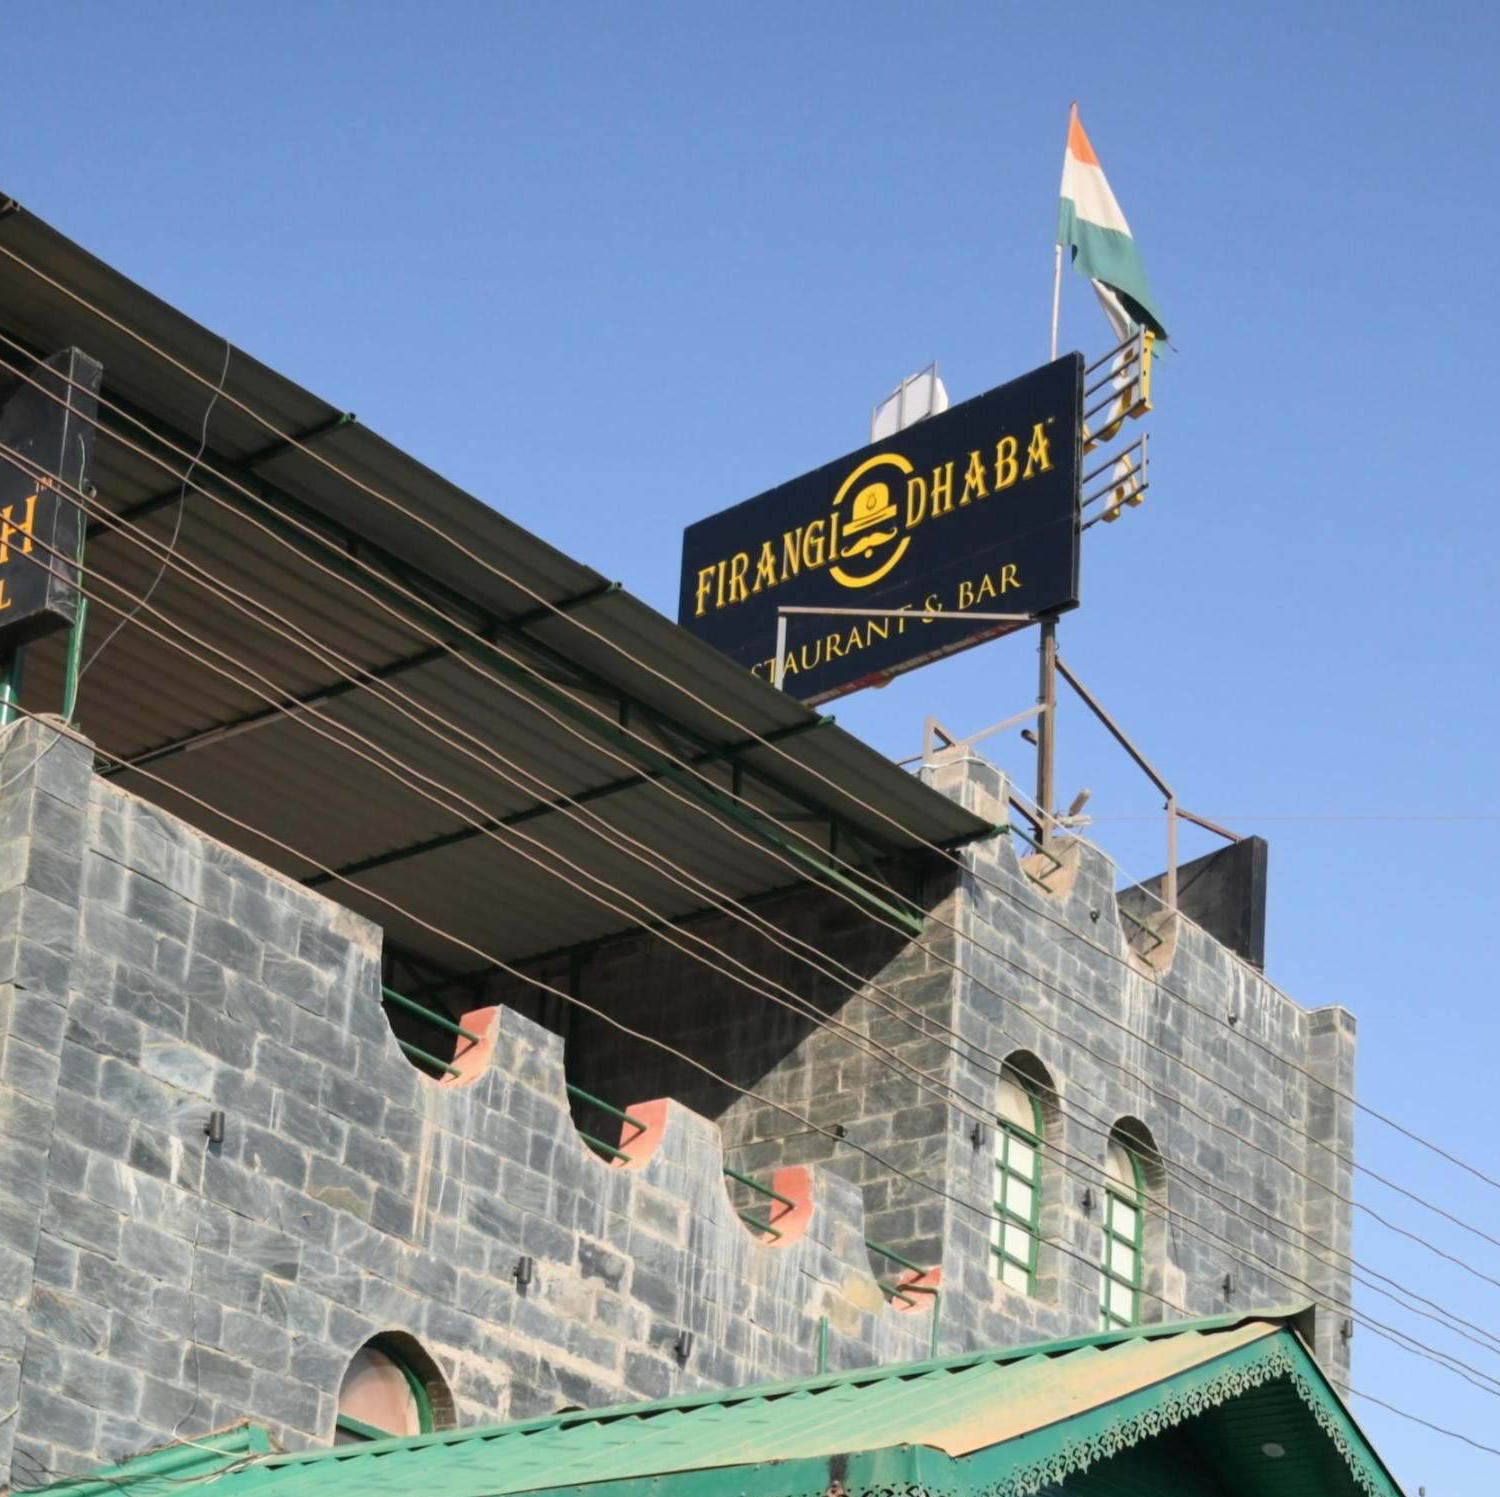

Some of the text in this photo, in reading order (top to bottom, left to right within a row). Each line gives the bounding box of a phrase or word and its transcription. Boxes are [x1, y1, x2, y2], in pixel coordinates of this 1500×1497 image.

[694, 422, 1054, 617] FIRANGI DHABA
[921, 593, 943, 624] &
[957, 563, 1023, 611] BAR
